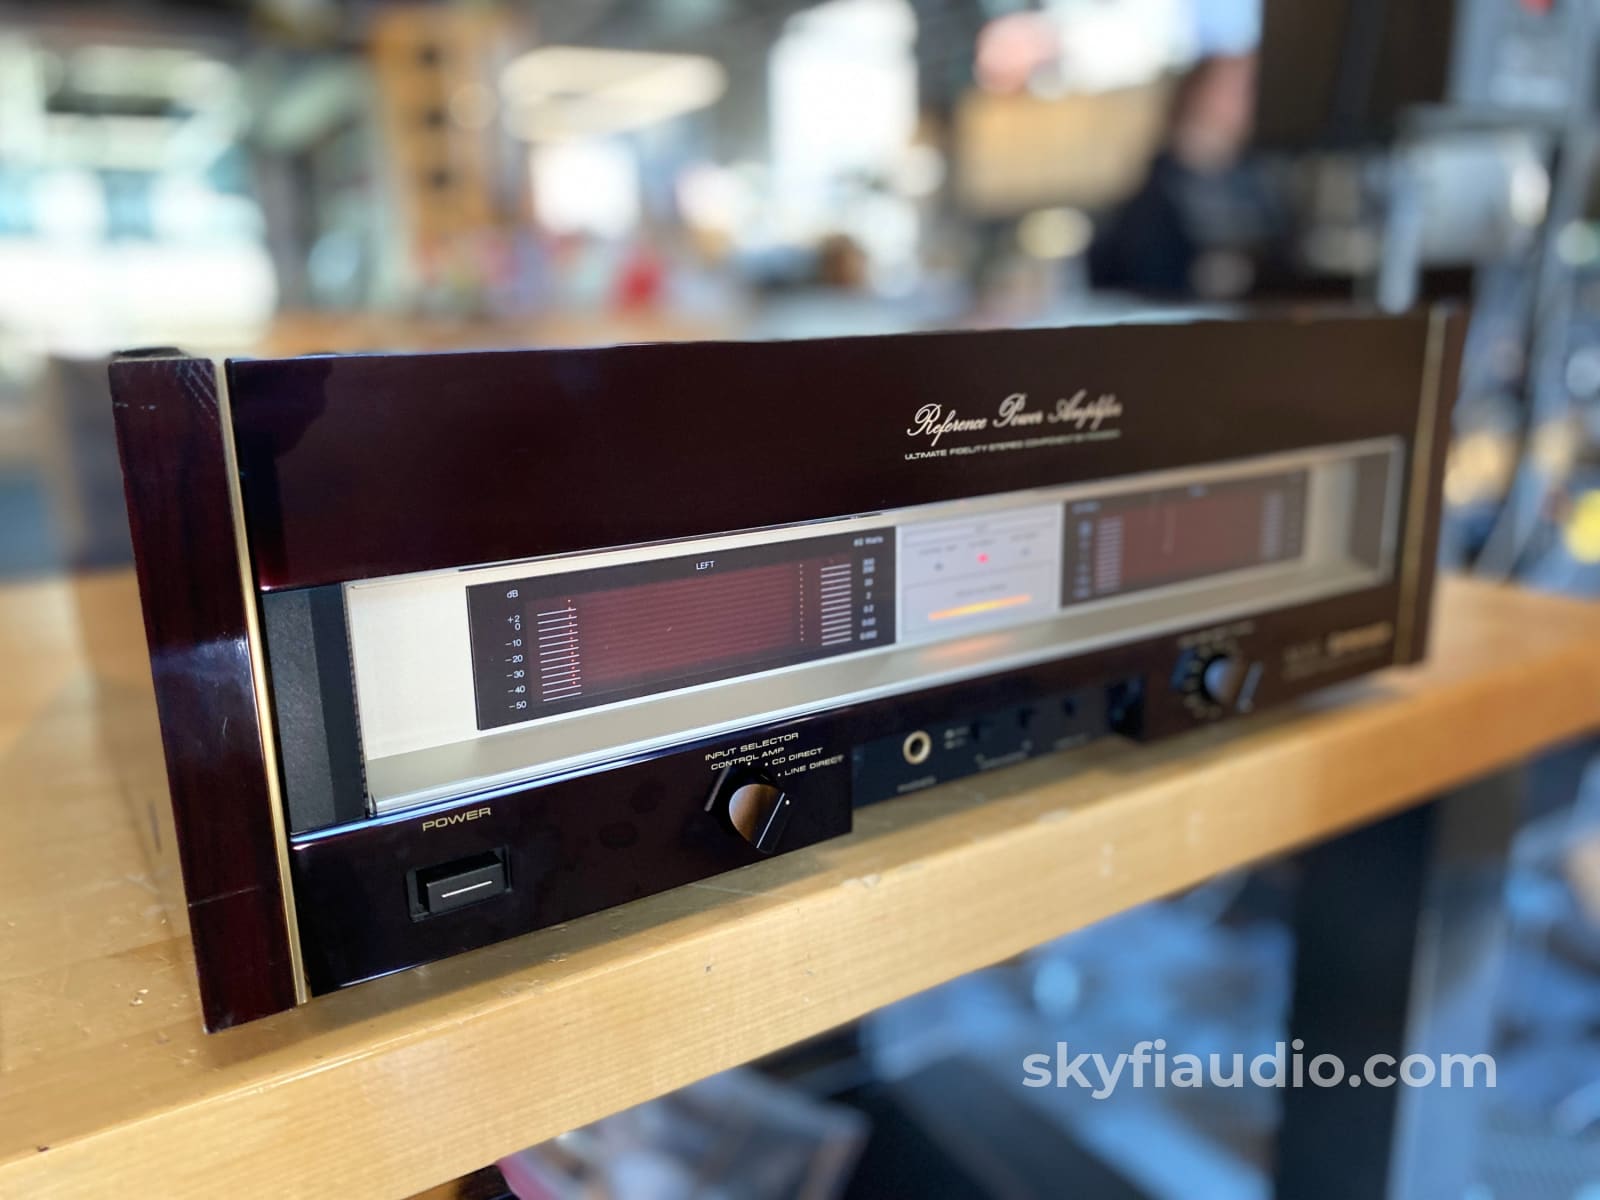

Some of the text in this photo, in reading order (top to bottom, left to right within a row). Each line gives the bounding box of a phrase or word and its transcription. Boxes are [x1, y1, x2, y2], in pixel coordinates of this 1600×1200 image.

[906, 402, 988, 448] Reference
[993, 392, 1044, 429] Power
[904, 448, 948, 461] ULTIMATE
[695, 560, 715, 570] LEFT
[506, 589, 519, 599] dB
[514, 622, 521, 631] 0
[704, 731, 799, 761] INPUT SELECTOR
[710, 746, 785, 771] CONTROL AMP
[771, 747, 823, 766] CD DIRECT
[784, 754, 844, 776] LINE DIRECT
[422, 807, 492, 832] POWER
